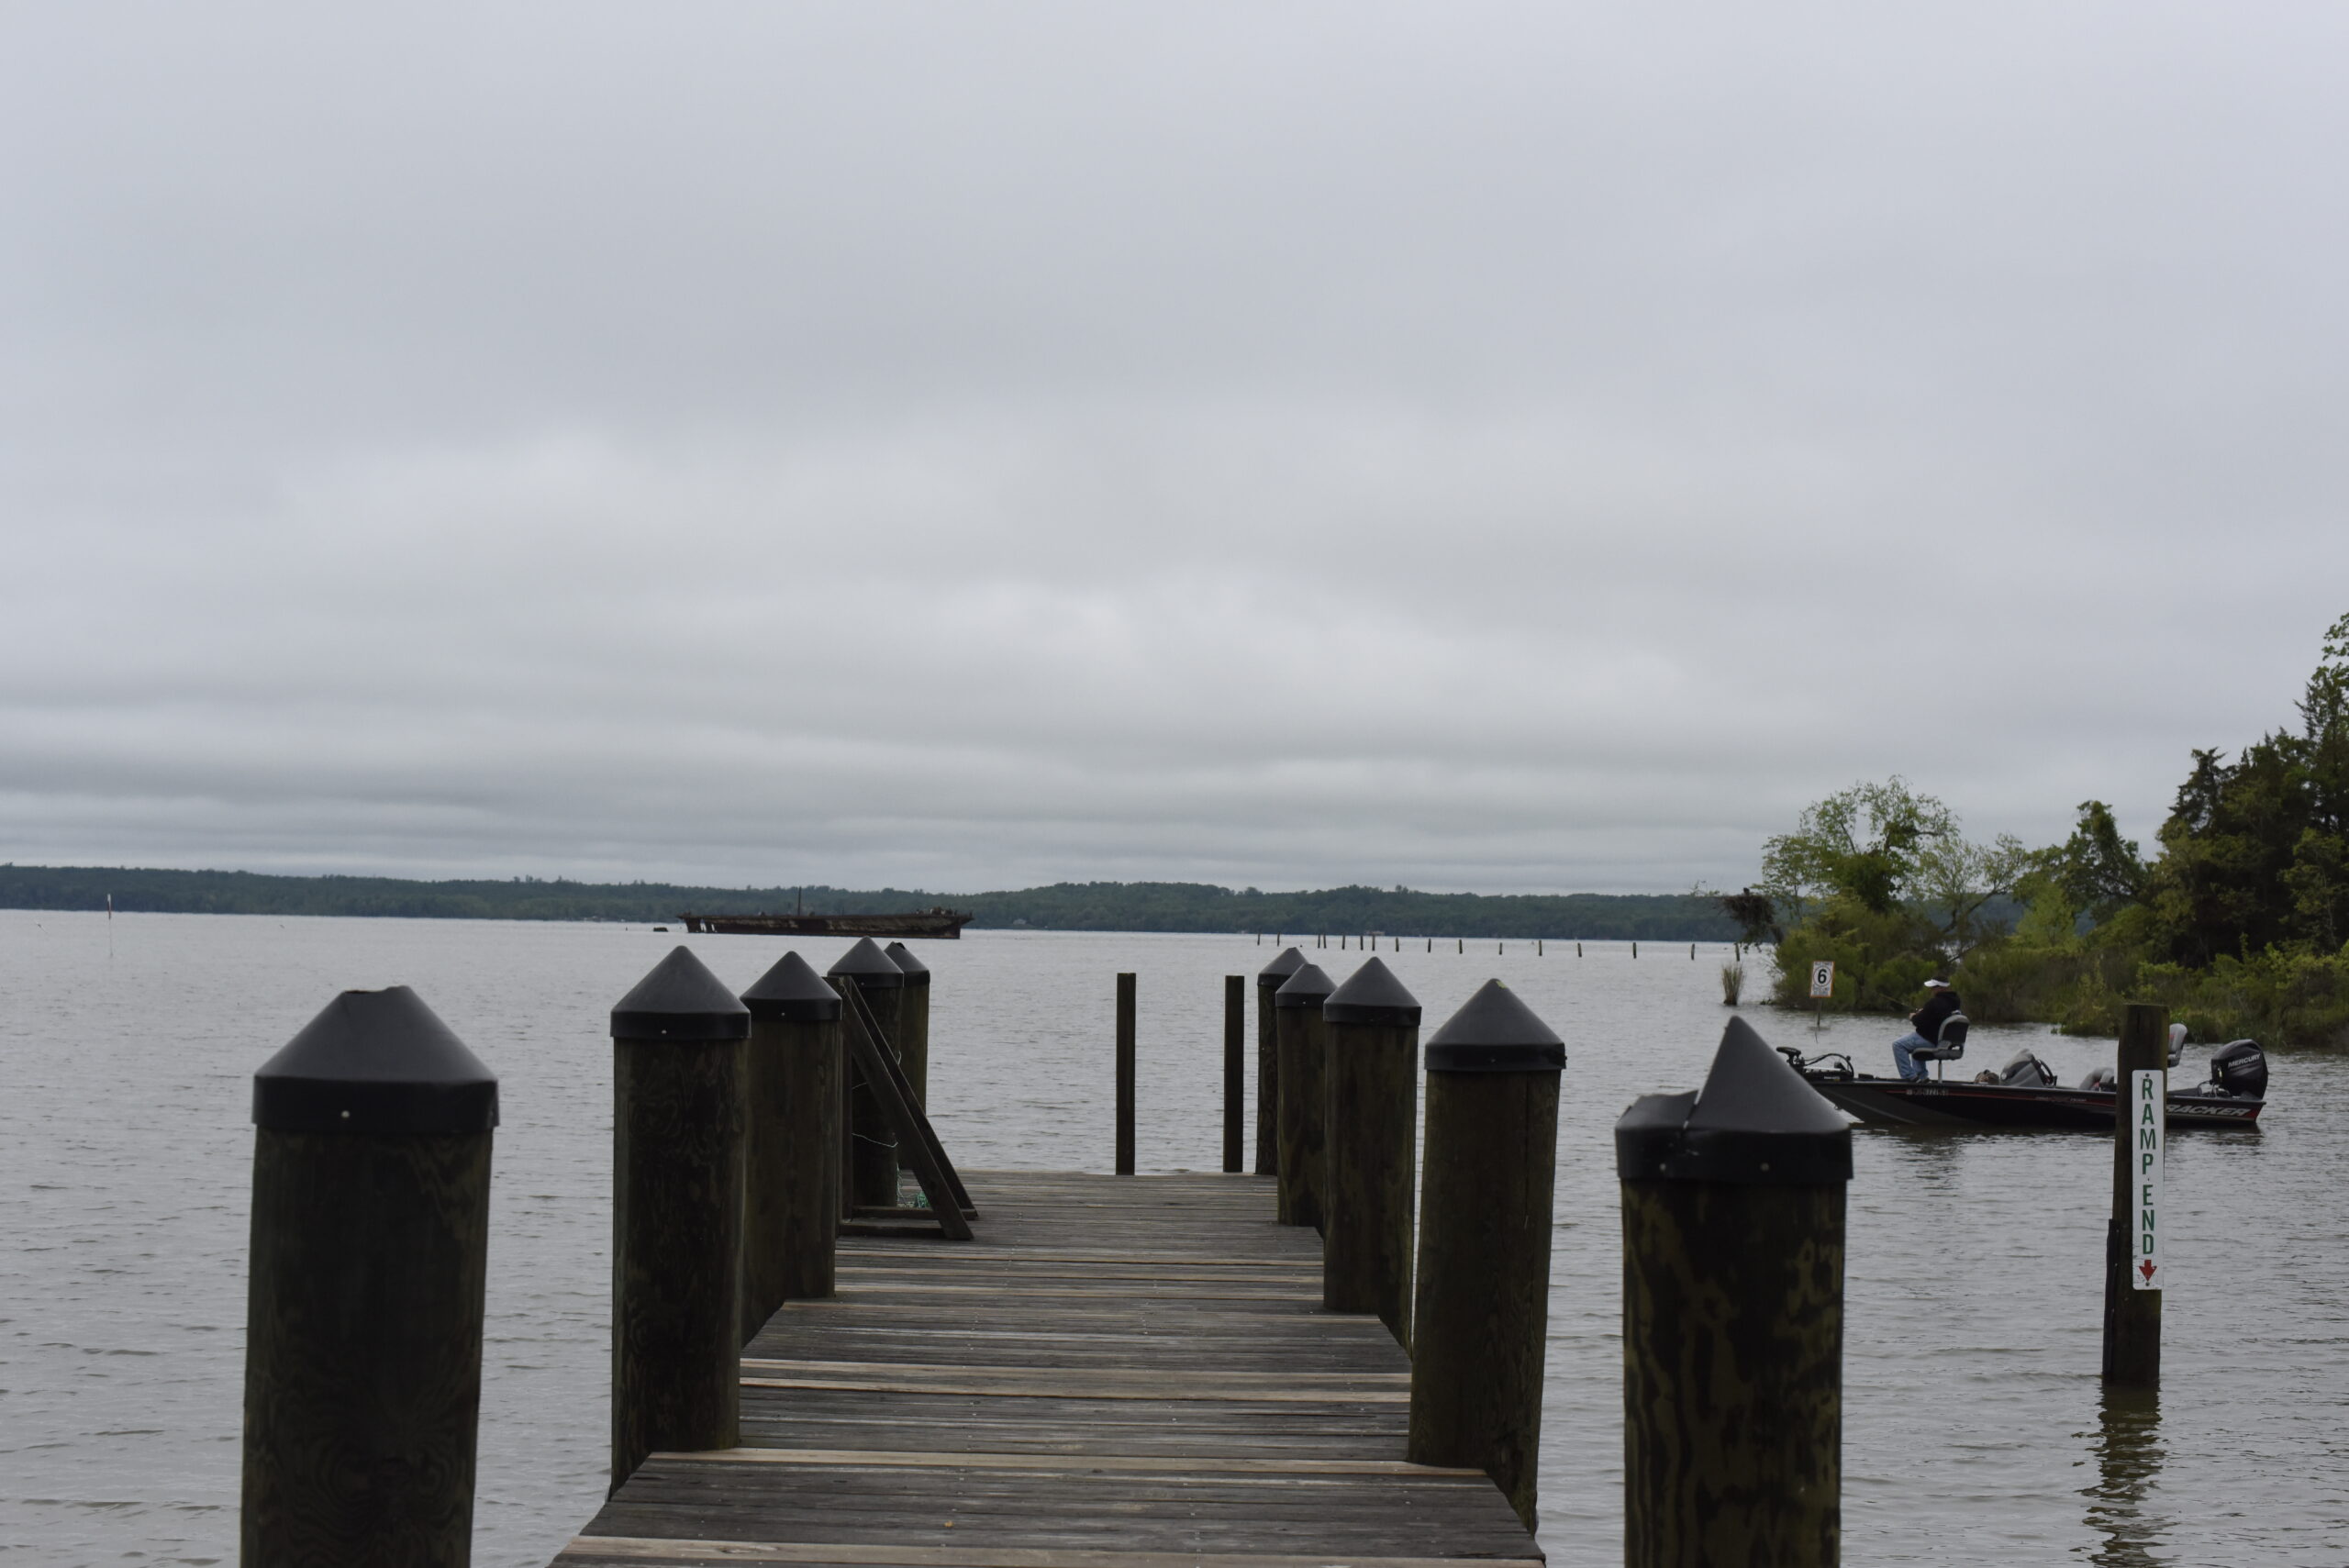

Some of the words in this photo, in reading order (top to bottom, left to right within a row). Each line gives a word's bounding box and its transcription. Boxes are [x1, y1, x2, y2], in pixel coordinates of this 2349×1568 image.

[1818, 969, 1827, 984] 6
[2228, 1053, 2261, 1069] MERCURY
[2165, 1104, 2252, 1117] RACKER
[2140, 1078, 2156, 1175] RAMP
[2142, 1184, 2155, 1255] END
